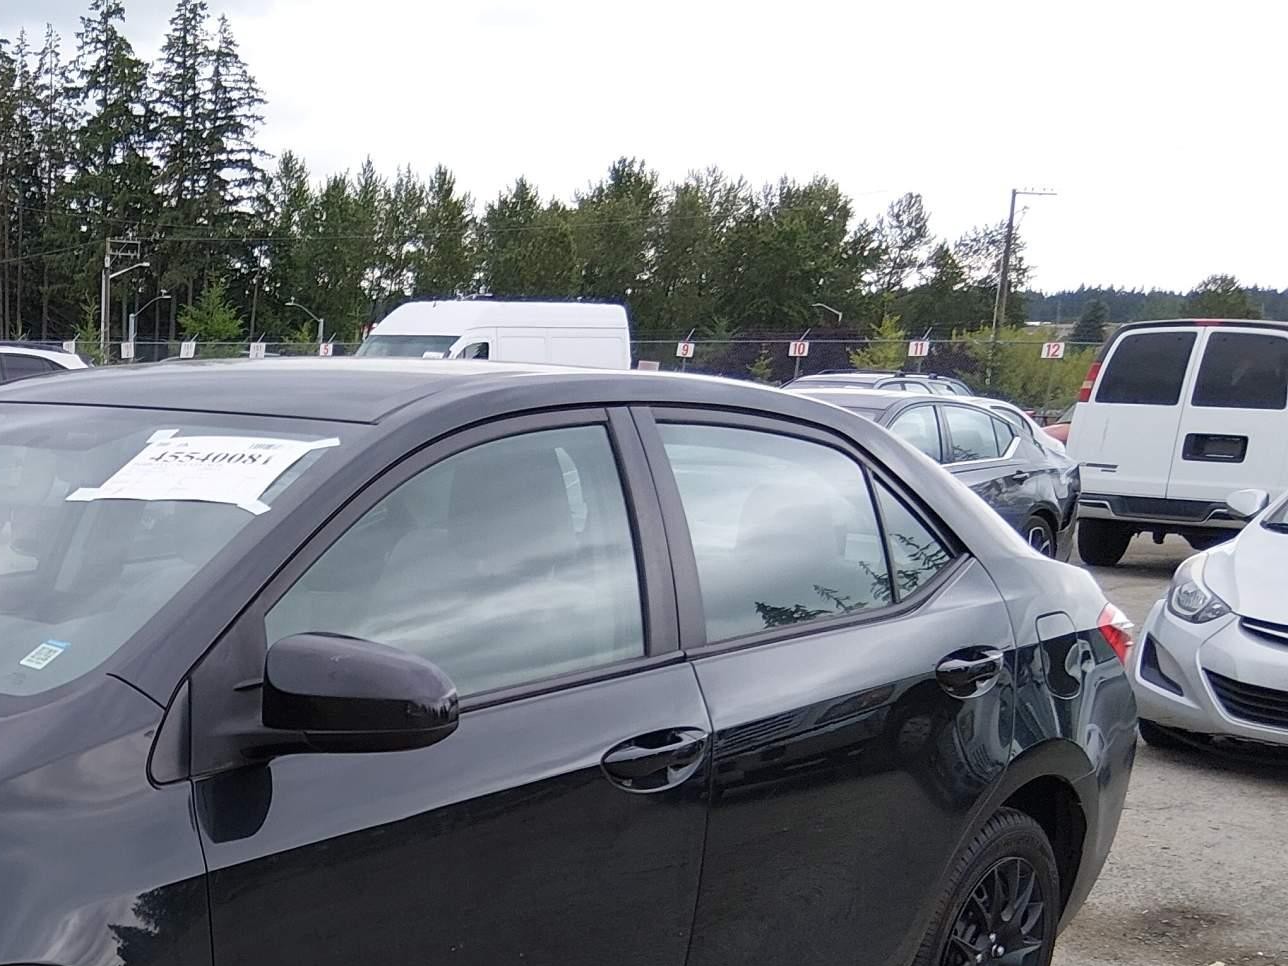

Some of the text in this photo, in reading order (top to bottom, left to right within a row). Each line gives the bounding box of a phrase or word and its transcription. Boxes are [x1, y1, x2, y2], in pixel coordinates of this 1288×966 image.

[681, 343, 689, 356] 9
[792, 342, 806, 355] 10
[913, 342, 925, 355] 11
[1045, 343, 1060, 357] 12
[149, 451, 273, 465] 45540081
